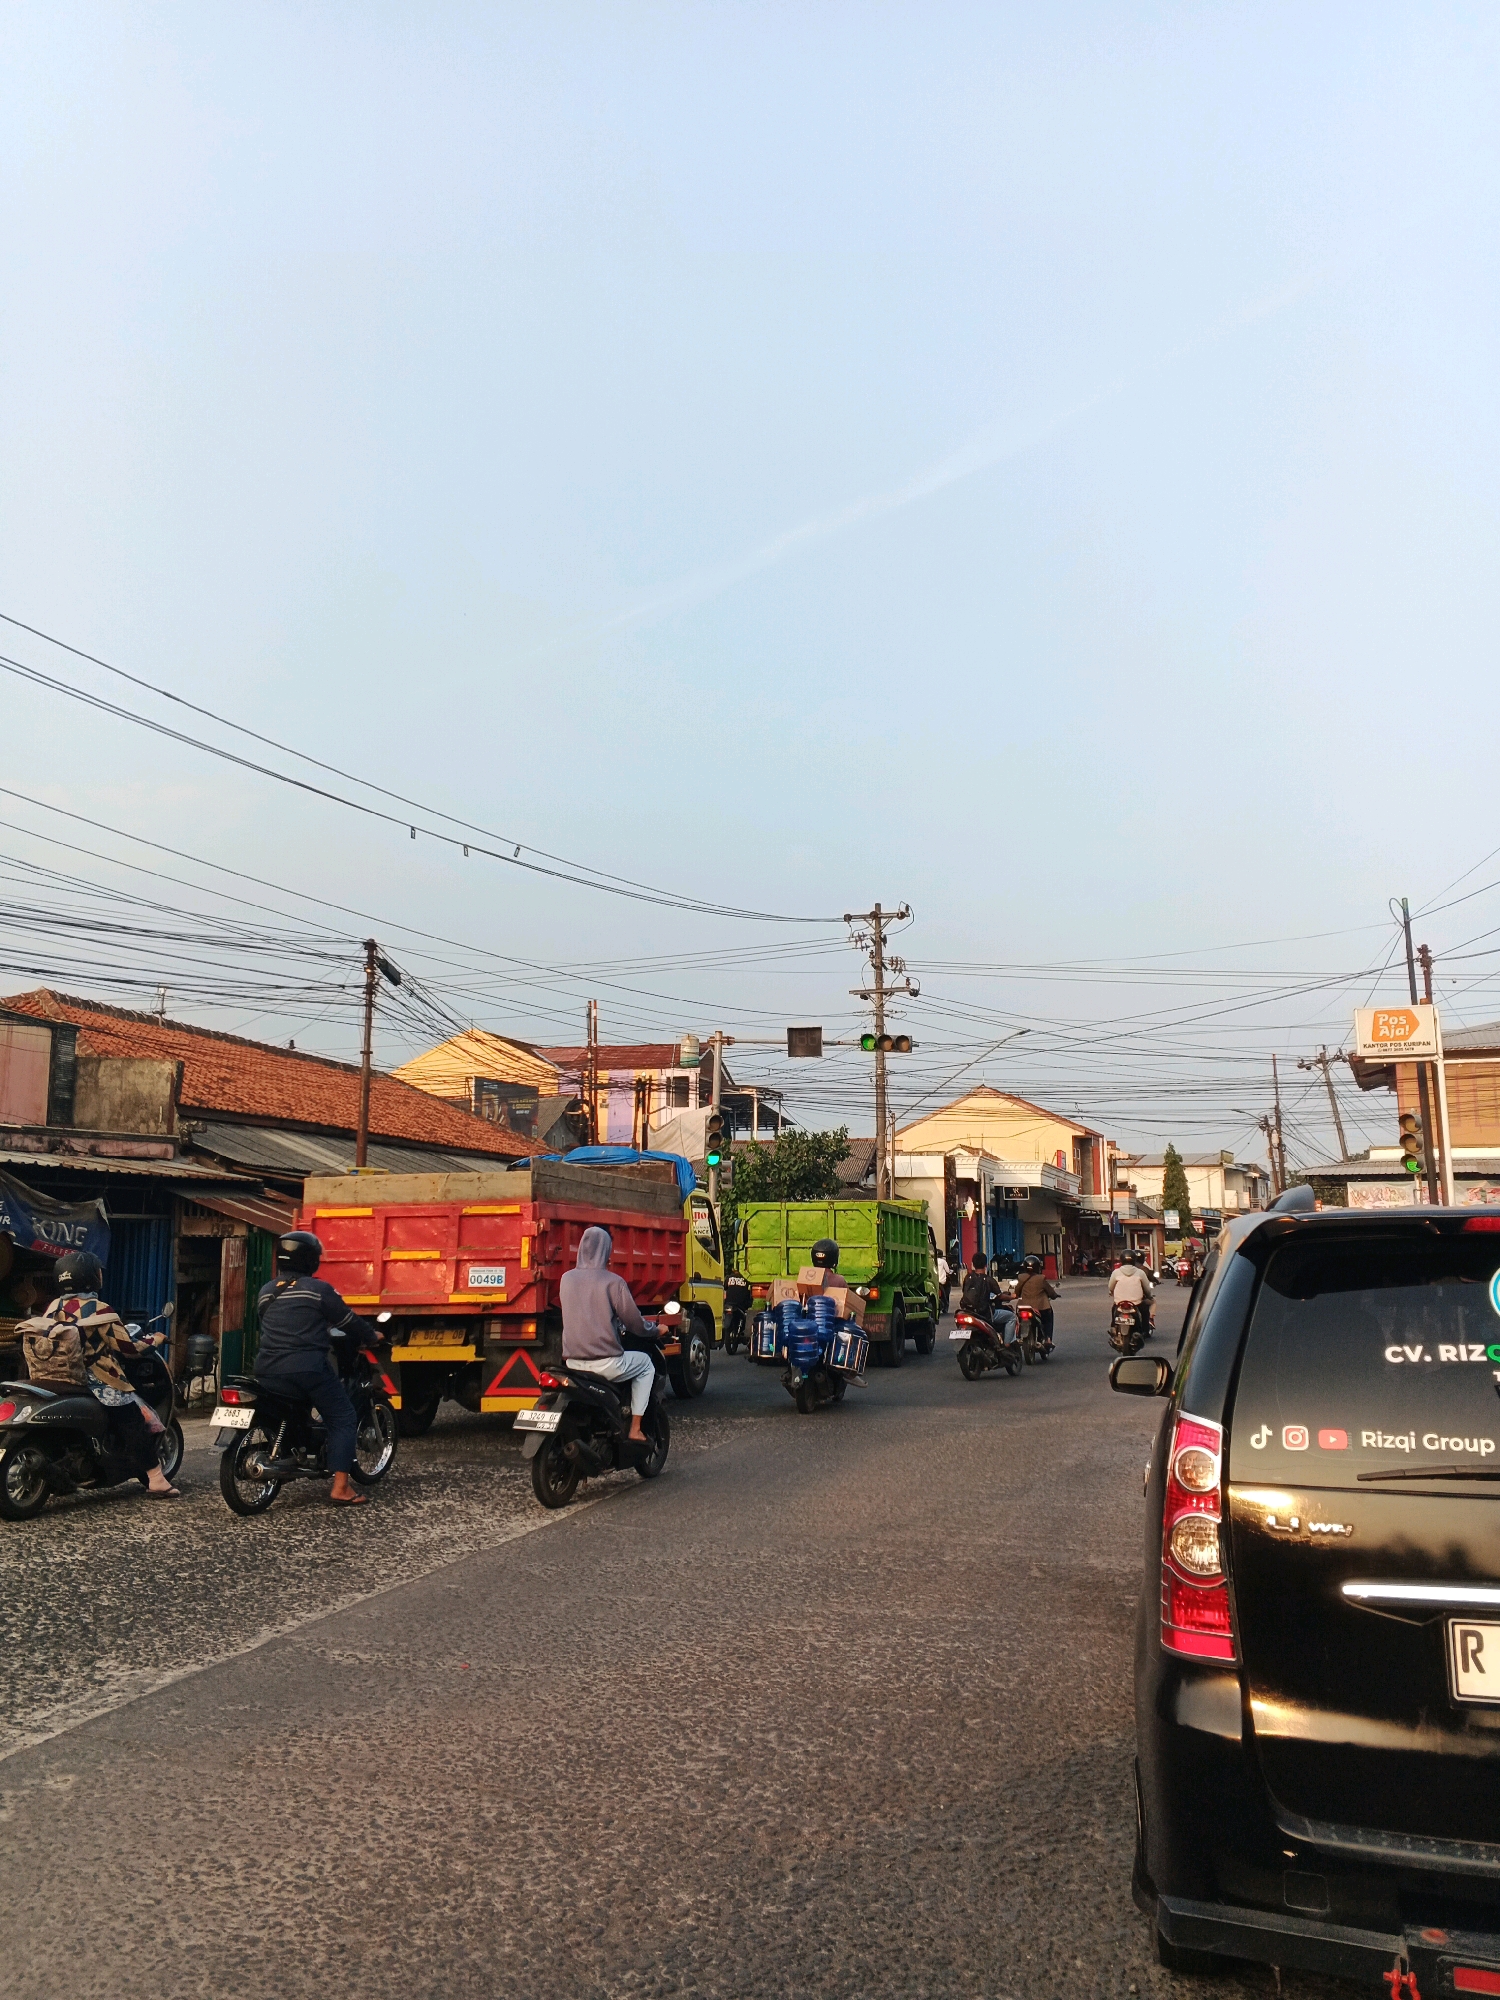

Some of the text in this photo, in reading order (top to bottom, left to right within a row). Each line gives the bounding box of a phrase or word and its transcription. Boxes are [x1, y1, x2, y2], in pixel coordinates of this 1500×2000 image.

[1377, 1014, 1407, 1025] Pos
[1379, 1025, 1410, 1039] Aja!
[470, 1274, 504, 1285] 0049B
[1384, 1345, 1432, 1362] CV.
[1361, 1431, 1496, 1456] Rizqi Group
[1459, 1629, 1486, 1674] R
